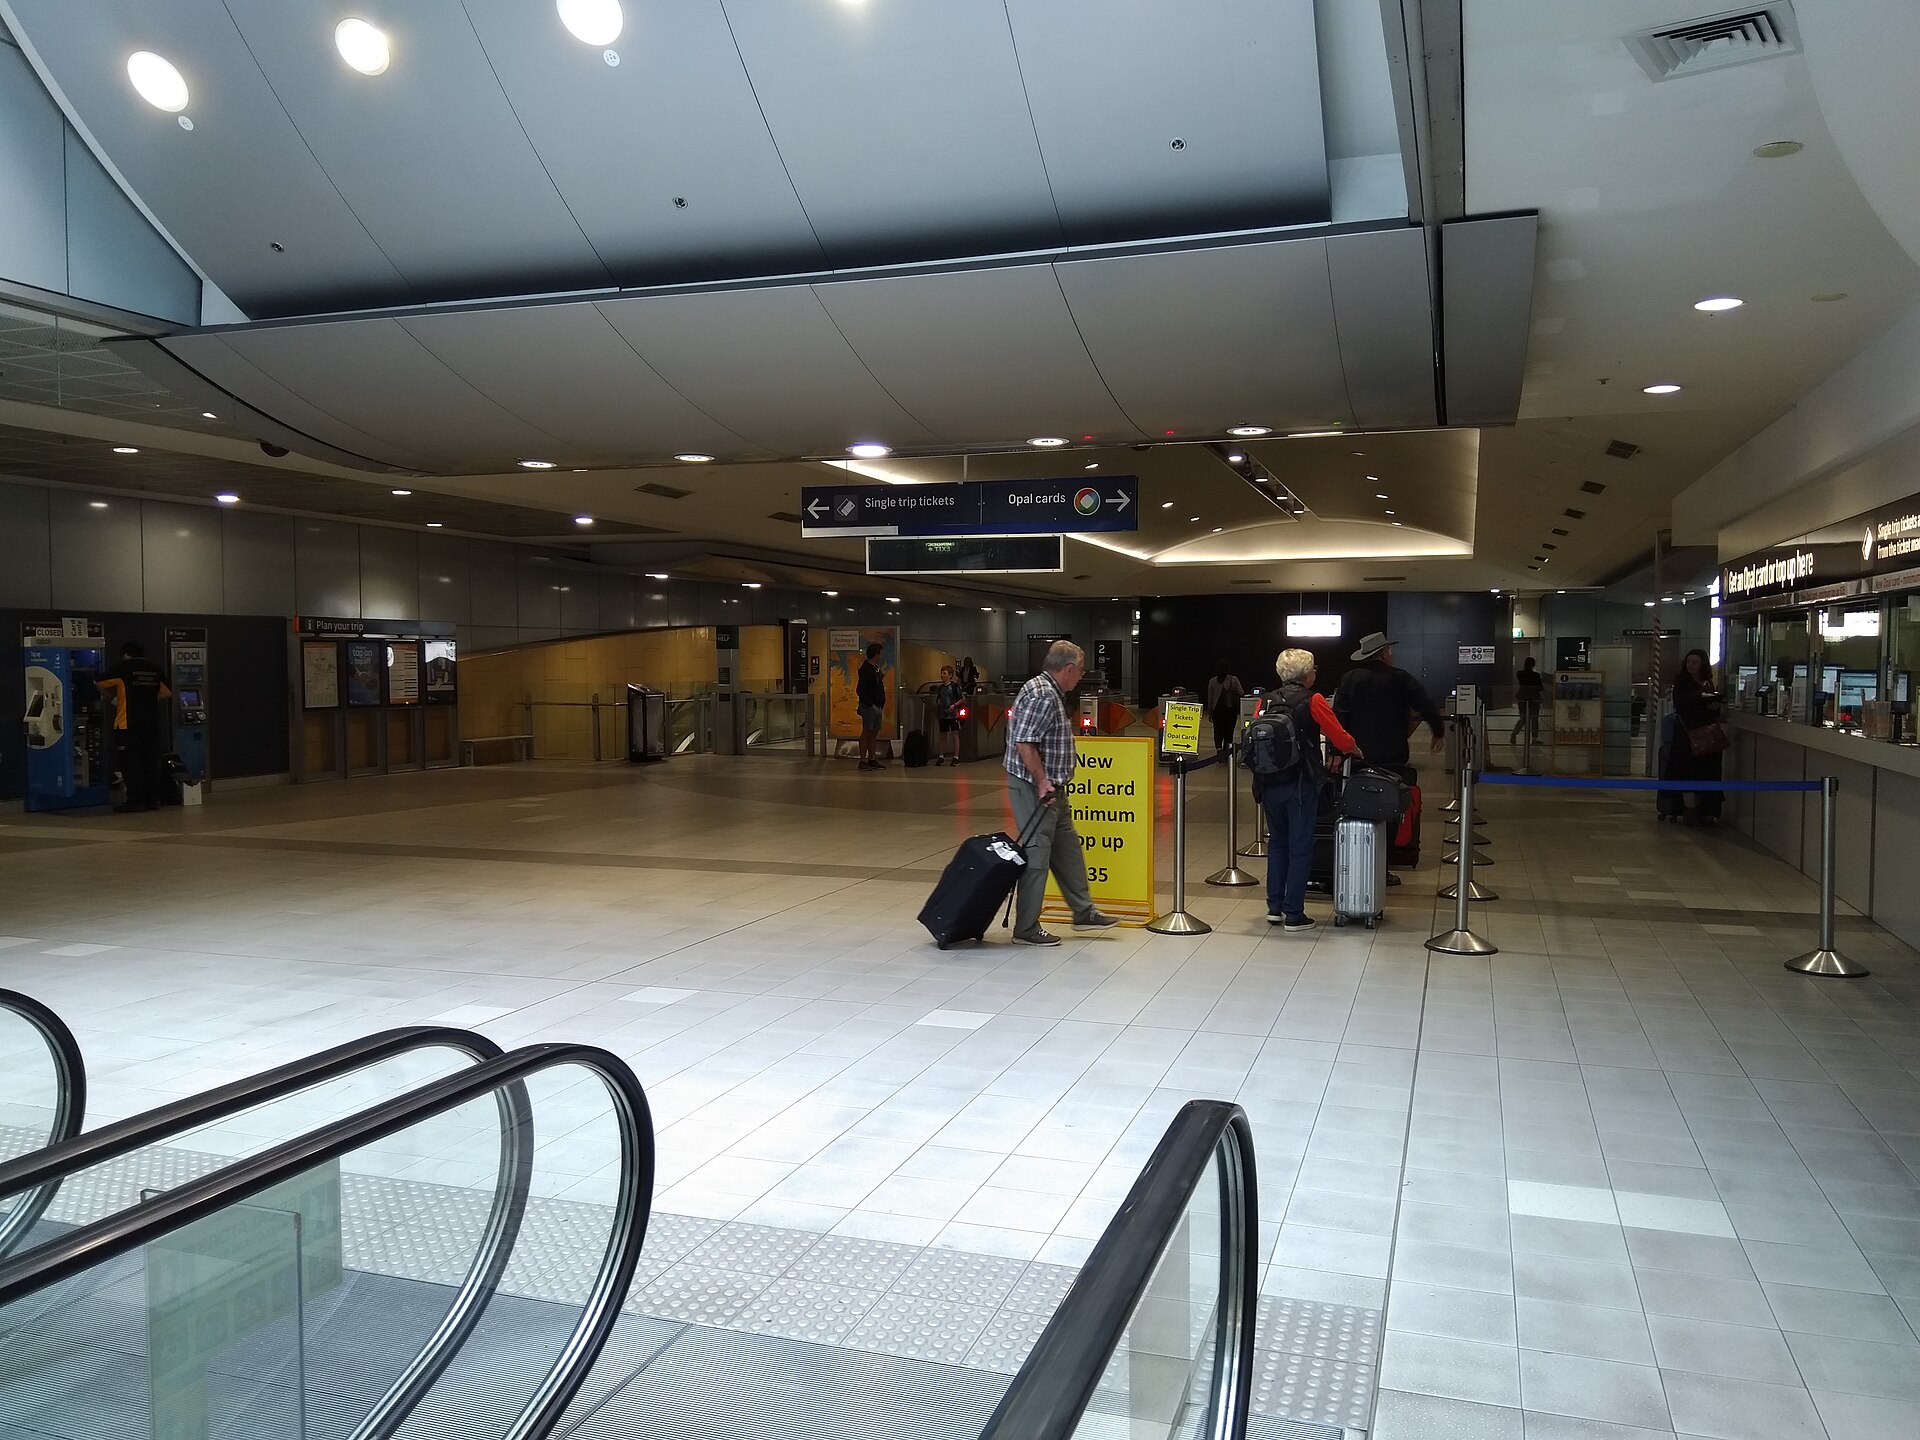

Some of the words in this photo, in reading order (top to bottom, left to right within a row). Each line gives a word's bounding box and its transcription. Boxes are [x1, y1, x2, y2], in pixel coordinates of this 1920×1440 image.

[865, 497, 896, 510] Single
[898, 496, 917, 509] trip
[919, 495, 955, 507] tickets
[1008, 493, 1033, 507] Opal
[1035, 493, 1066, 504] cards
[1878, 521, 1892, 540] Single
[1891, 518, 1900, 536] trip
[1900, 514, 1918, 532] tickets
[1878, 544, 1889, 560] from
[1889, 541, 1897, 557] the
[1897, 538, 1911, 555] ticket
[1728, 571, 1738, 594] Get
[1737, 573, 1744, 592] an
[1743, 563, 1756, 596] Opal
[1756, 559, 1769, 588] card
[1769, 563, 1776, 585] or
[1776, 559, 1787, 589] top
[1787, 557, 1796, 587] up
[1796, 549, 1814, 578] here
[37, 629, 62, 637] CLOSED
[316, 621, 333, 631] Plan
[334, 622, 350, 633] your
[350, 622, 364, 633] trip
[801, 629, 807, 644] 2
[352, 648, 363, 658] tap
[363, 649, 373, 657] on
[1098, 644, 1105, 654] 2
[1579, 641, 1586, 652] 1
[1076, 753, 1113, 768] New
[1066, 779, 1092, 797] pal
[1097, 780, 1135, 796] card
[1069, 805, 1135, 823] inimum
[1078, 835, 1096, 851] op
[1102, 836, 1124, 852] up
[1087, 866, 1109, 882] 35
